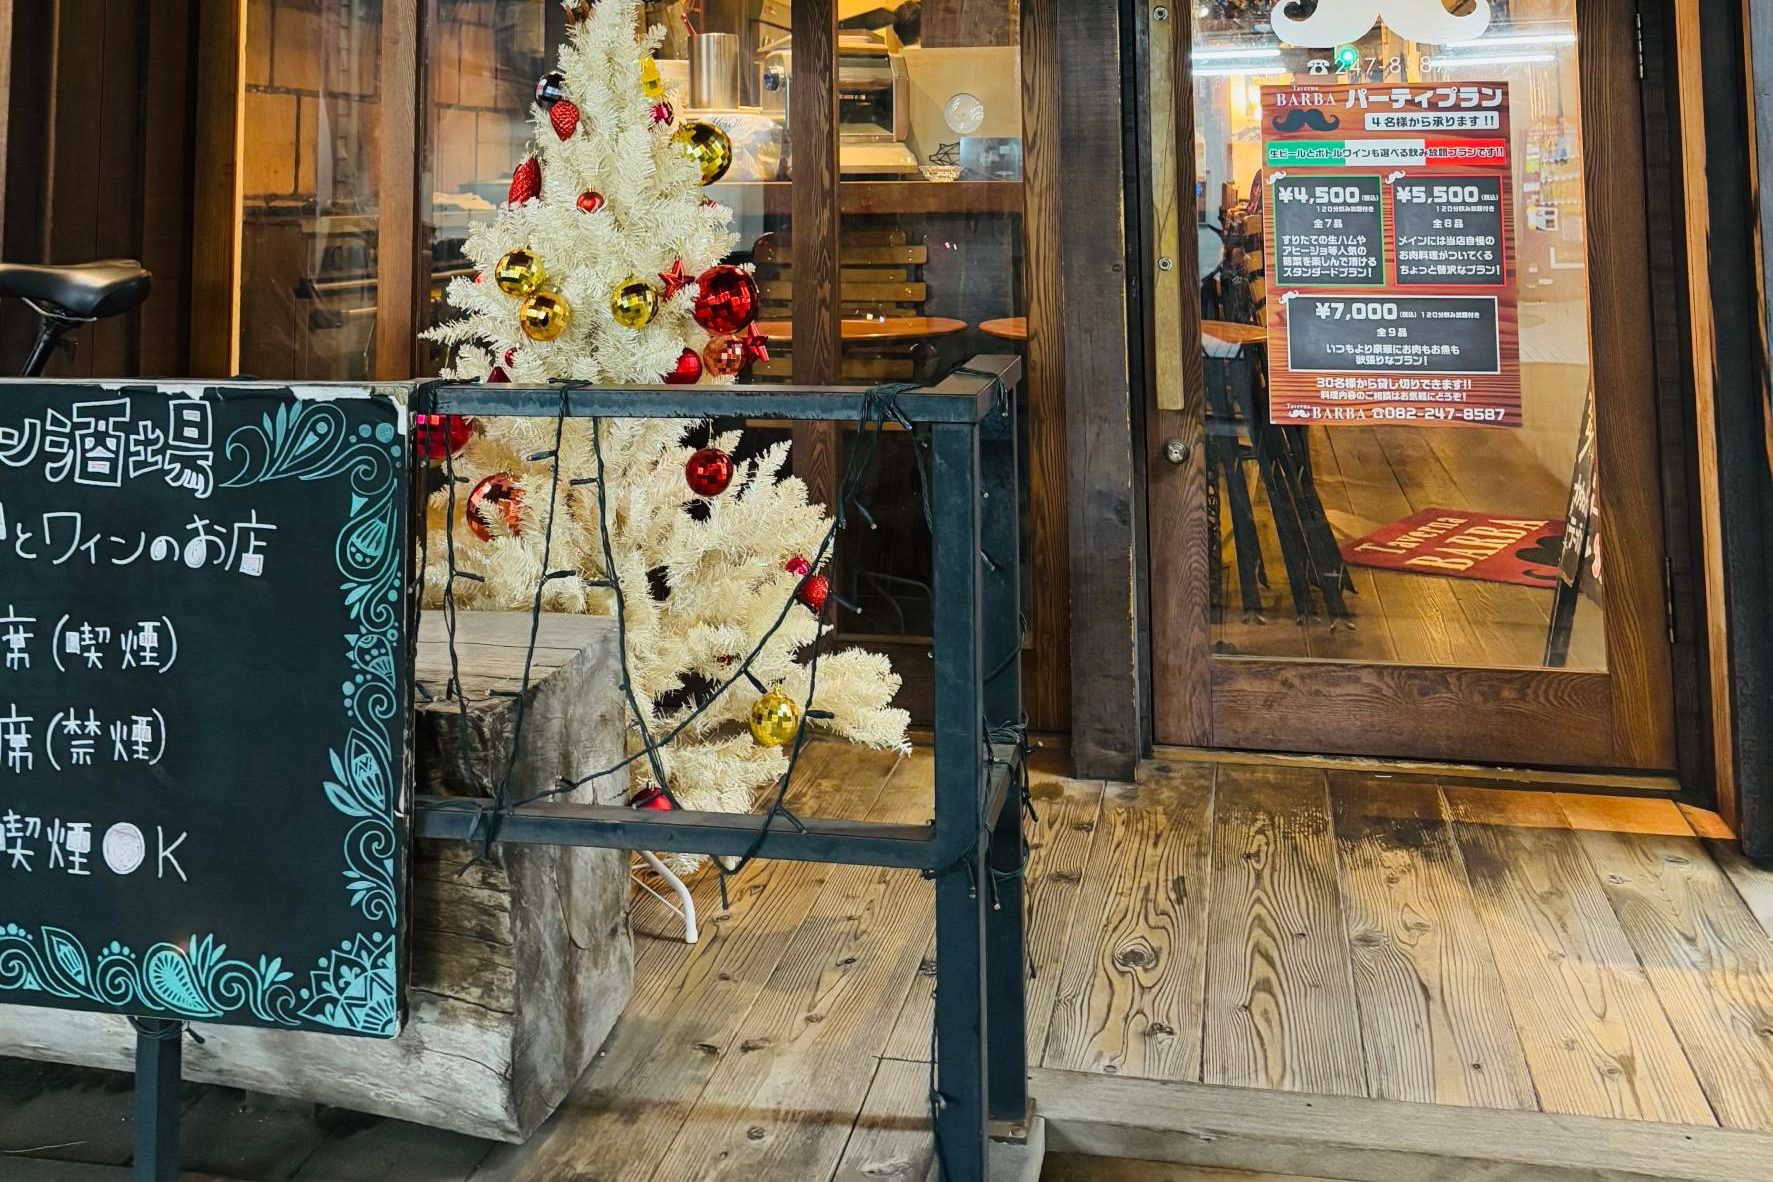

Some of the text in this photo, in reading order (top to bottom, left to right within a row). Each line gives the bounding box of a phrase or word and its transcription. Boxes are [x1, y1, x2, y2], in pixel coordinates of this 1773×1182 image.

[1276, 92, 1336, 106] BARBA
[1345, 88, 1503, 109] パーティプラン
[1278, 186, 1359, 204] ¥4,500
[1396, 186, 1479, 204] ¥5,500
[1315, 302, 1398, 321] ¥7,000
[1312, 406, 1366, 420] BARBA
[1385, 408, 1505, 421] 082-247-8587
[1354, 517, 1470, 555] Taverna
[1405, 518, 1550, 572] BARBA
